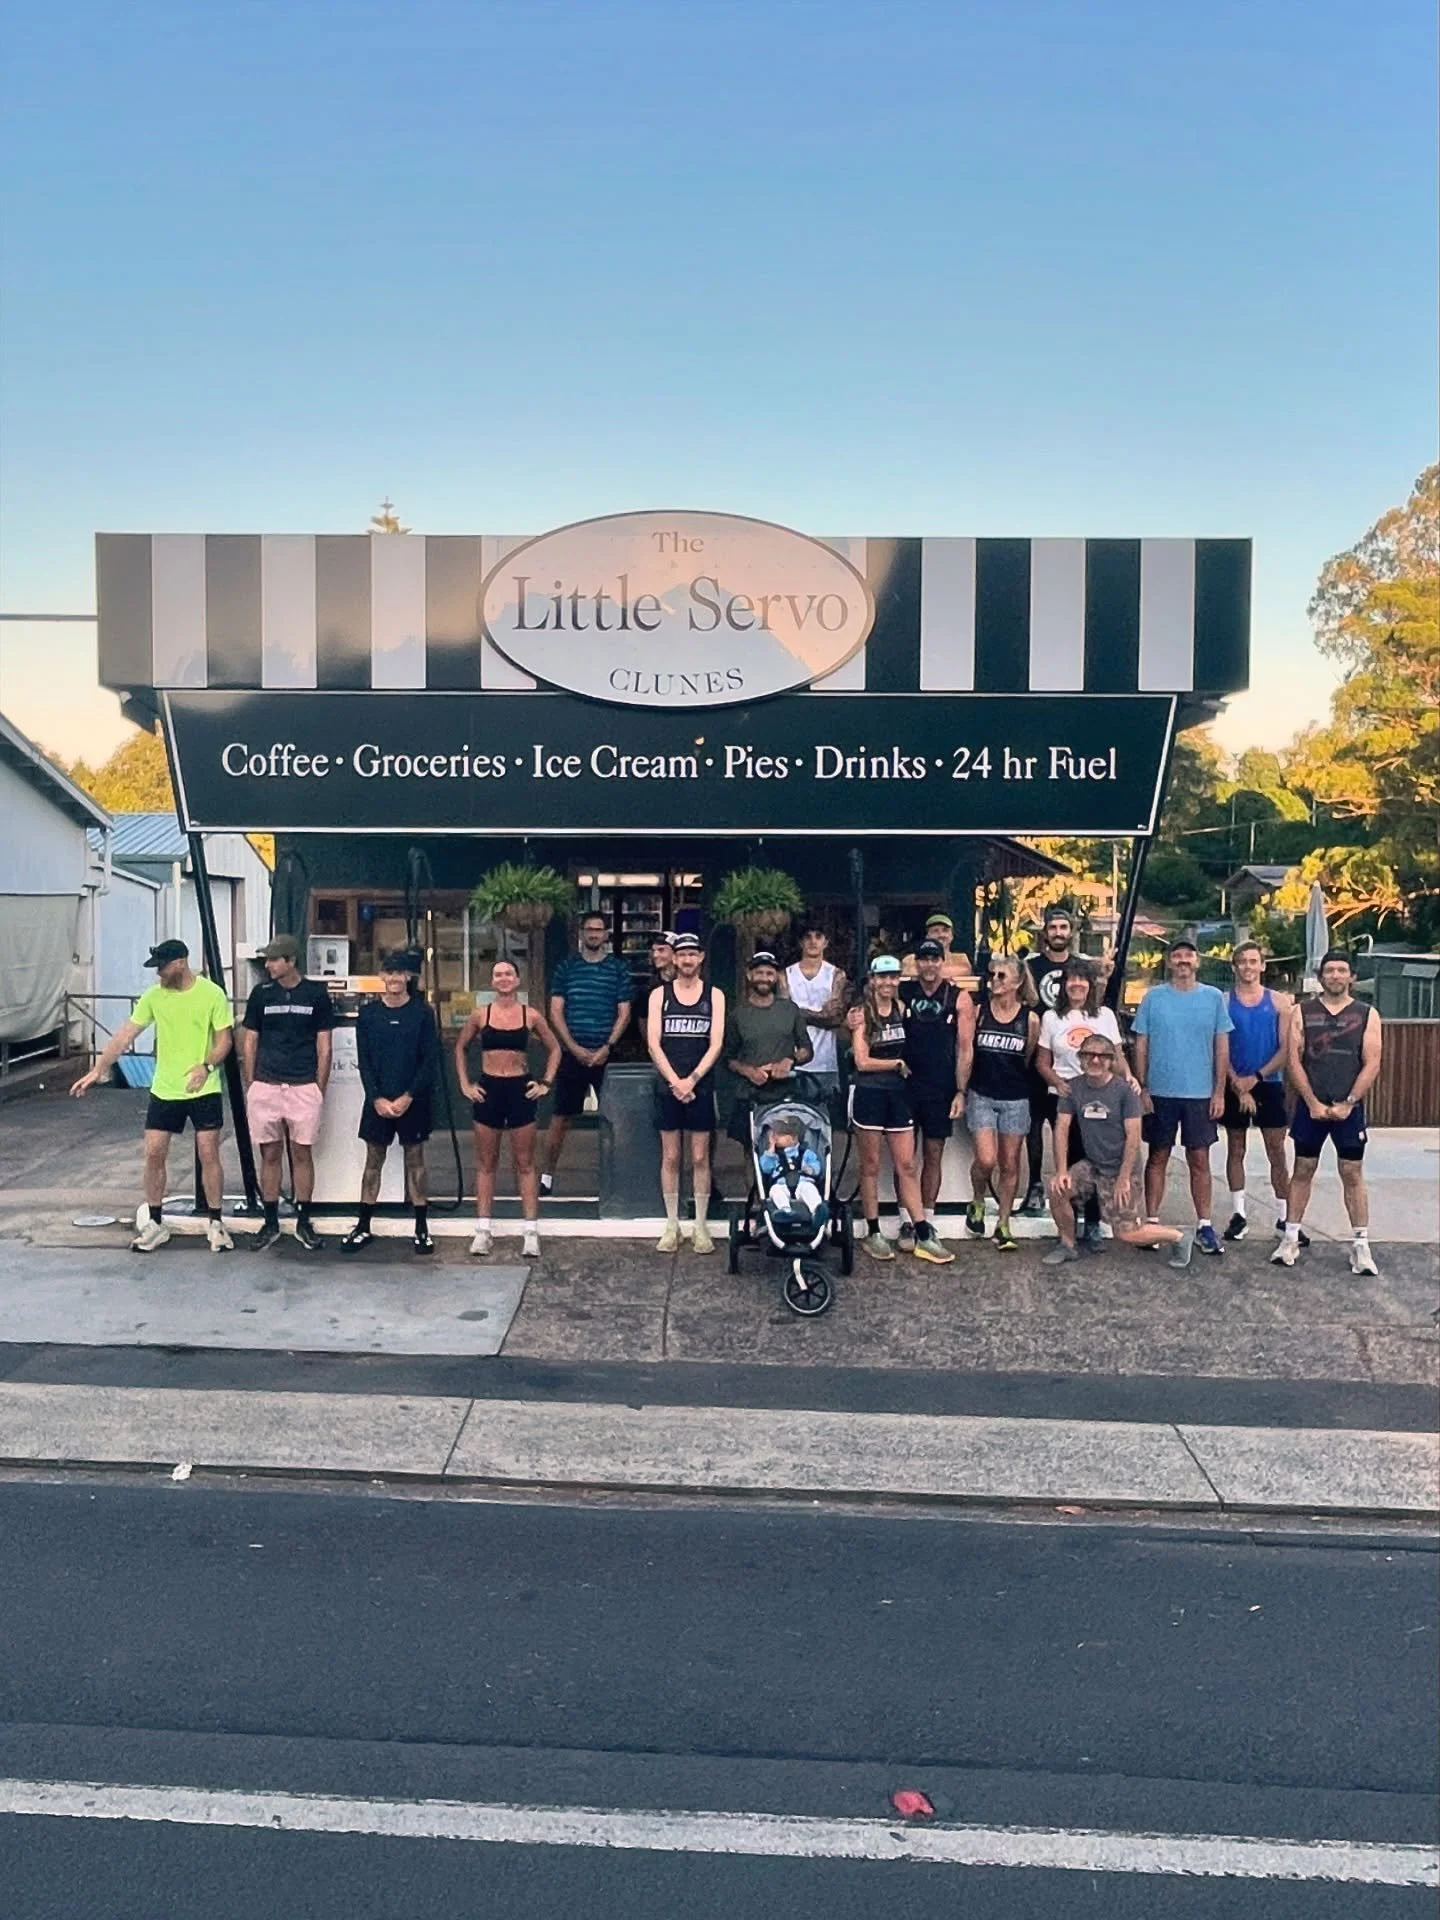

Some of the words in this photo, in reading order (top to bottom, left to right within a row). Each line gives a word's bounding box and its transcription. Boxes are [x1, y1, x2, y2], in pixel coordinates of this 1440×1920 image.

[652, 531, 705, 553] The
[511, 573, 663, 632] Little
[688, 575, 849, 632] Servo
[609, 667, 744, 696] CLUNES
[221, 743, 329, 778] Coffee
[352, 743, 507, 779] Groceries
[532, 745, 582, 779] Ice
[590, 745, 699, 779] Cream
[723, 745, 789, 779] Pies
[814, 745, 927, 780] Drinks
[951, 746, 993, 780] 24
[1003, 746, 1037, 780] hr
[1047, 747, 1118, 781] Fuel
